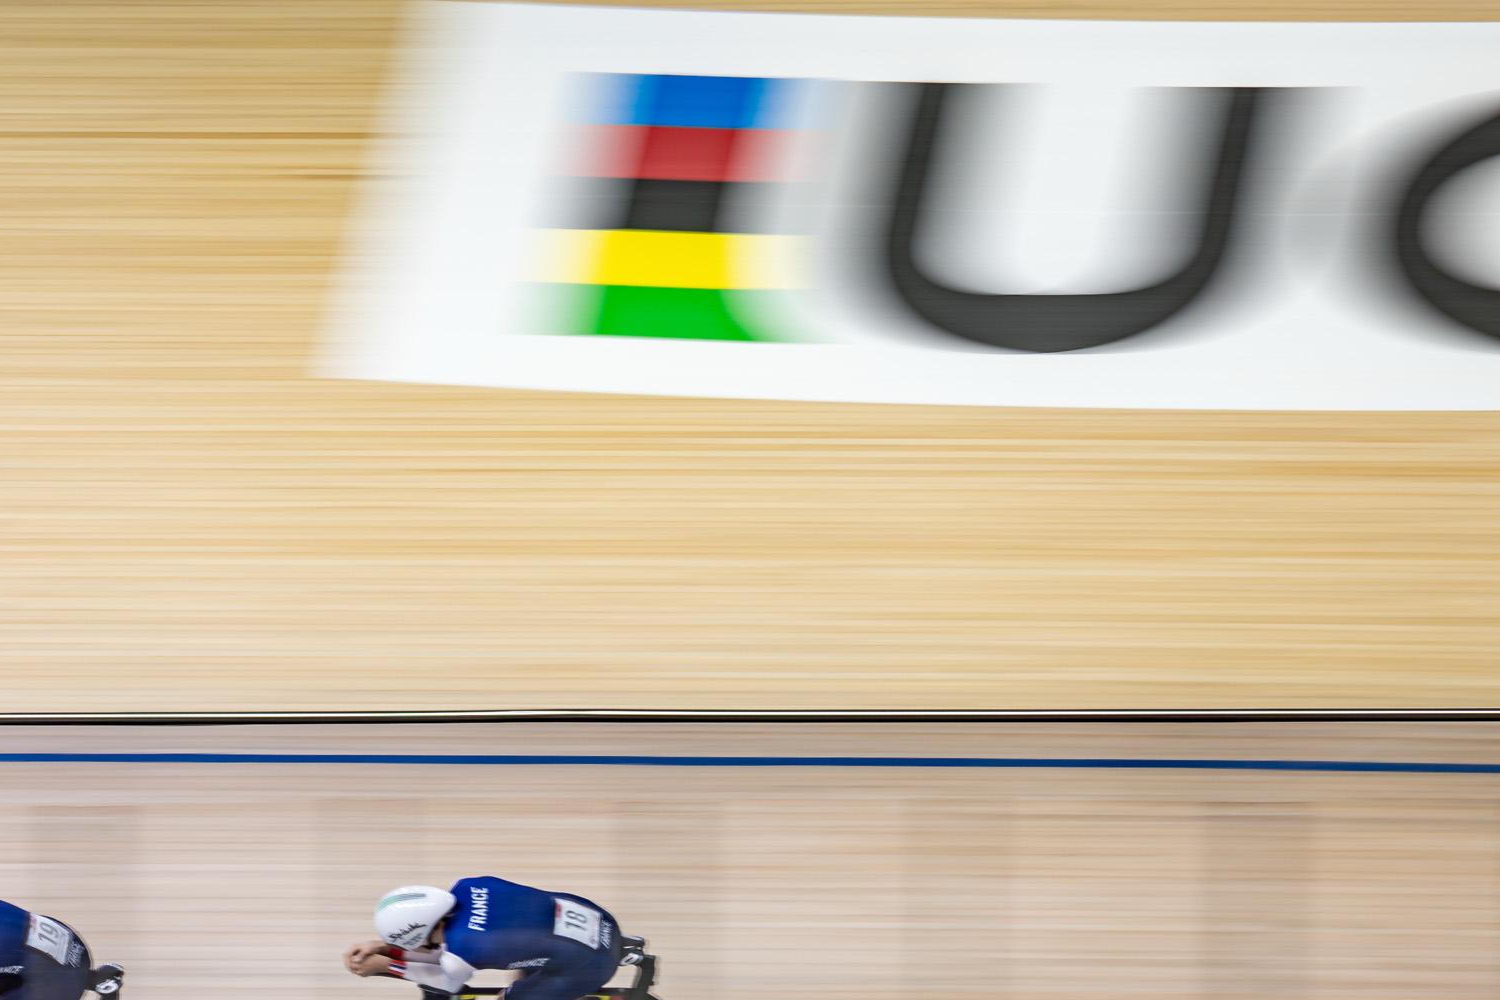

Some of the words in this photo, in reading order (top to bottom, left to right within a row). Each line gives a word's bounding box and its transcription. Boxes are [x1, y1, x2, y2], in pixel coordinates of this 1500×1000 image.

[468, 886, 490, 932] FRANCE
[563, 910, 588, 932] 18
[37, 921, 60, 945] 19
